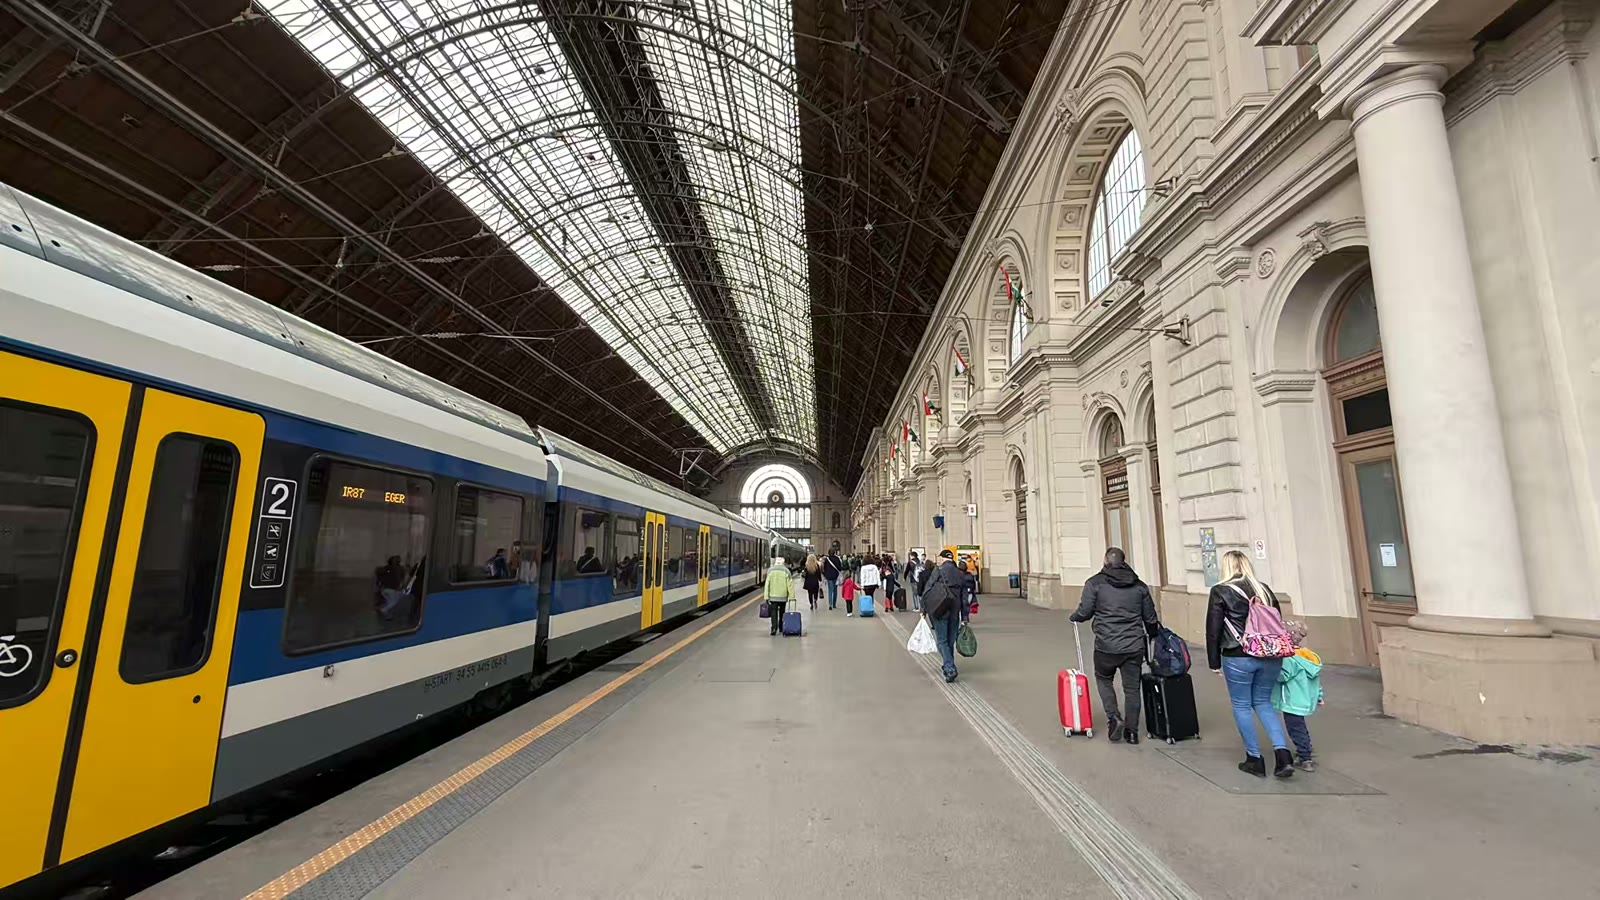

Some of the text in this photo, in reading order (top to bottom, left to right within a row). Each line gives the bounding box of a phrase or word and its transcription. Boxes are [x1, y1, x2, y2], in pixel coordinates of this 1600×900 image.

[268, 483, 289, 515] 2
[342, 486, 406, 504] IR87 EGER
